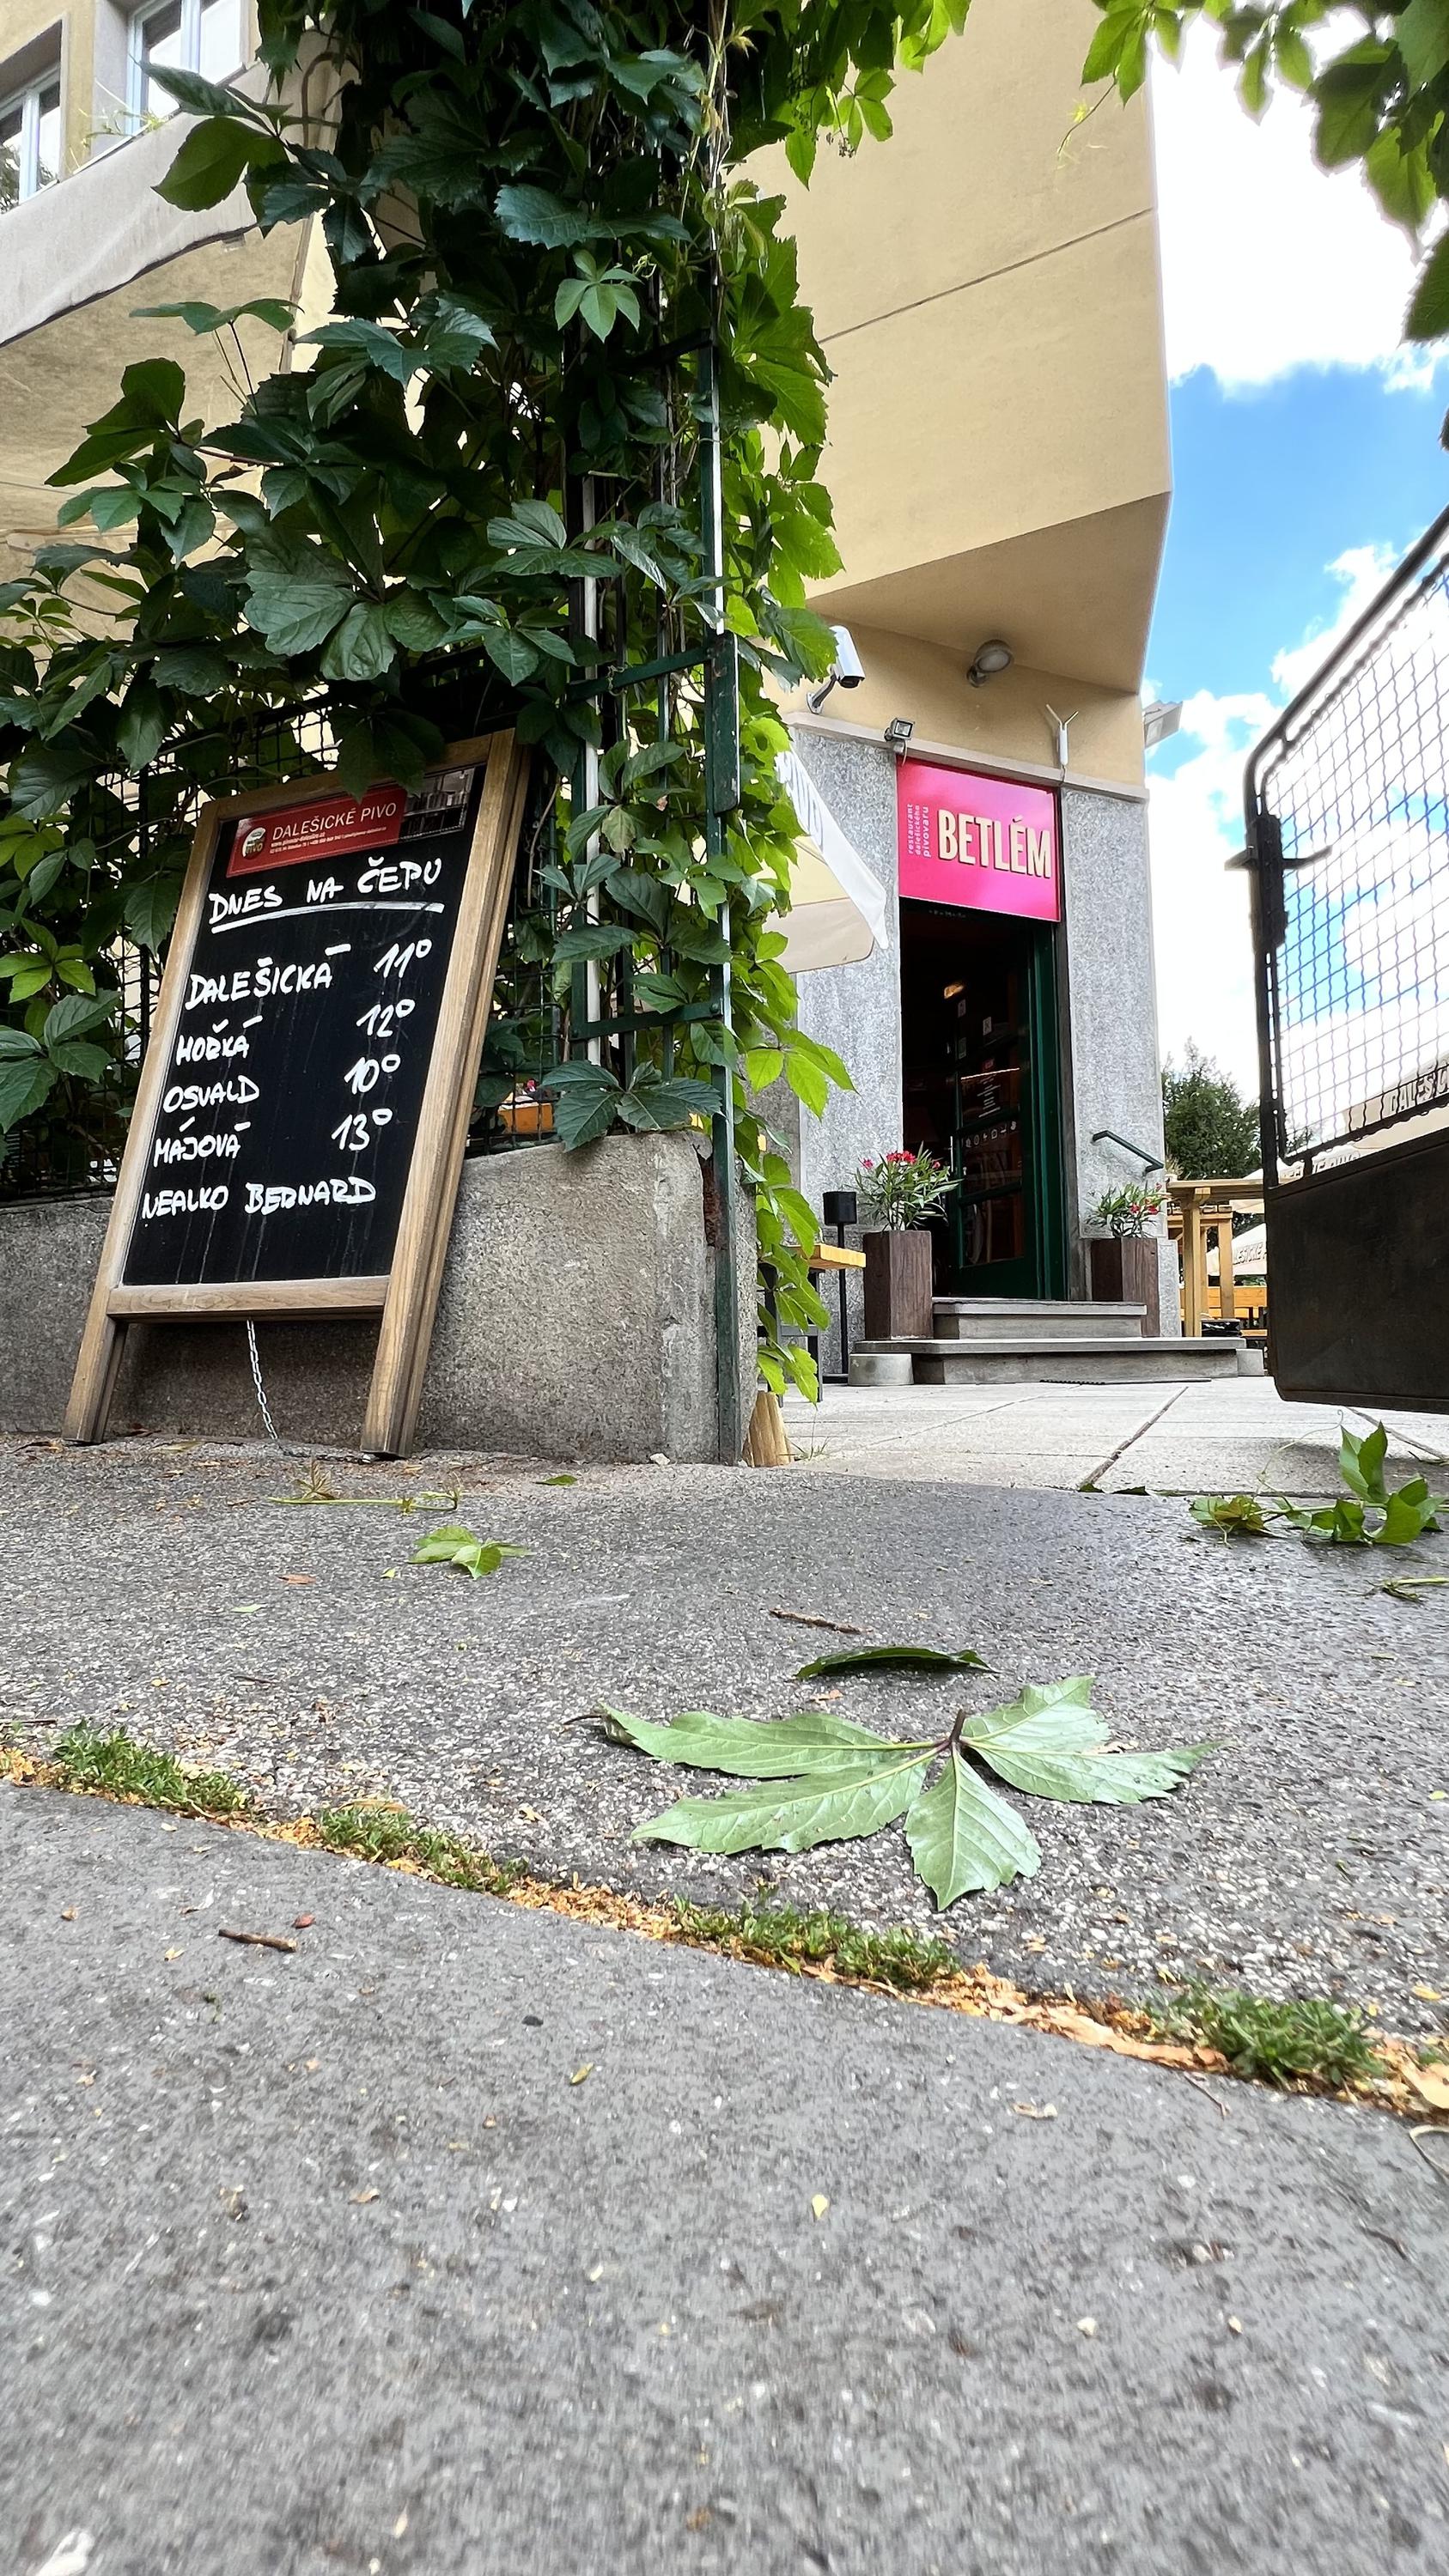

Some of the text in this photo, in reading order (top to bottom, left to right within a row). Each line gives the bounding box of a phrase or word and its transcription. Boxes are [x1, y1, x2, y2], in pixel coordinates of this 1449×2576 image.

[272, 807, 355, 841] DALEŠICKÉ
[360, 802, 397, 823] PIVO
[922, 806, 931, 858] pivovaru
[937, 809, 1051, 879] BETLÉM
[209, 856, 441, 924] DNES NA ČEPU
[185, 944, 351, 1011] DALEŠICKÁ
[175, 1014, 263, 1066] HOŘKÁ
[162, 1075, 259, 1114] OSVALD
[153, 1116, 251, 1168] MÁJOVÁ
[141, 1176, 376, 1219] NEALKO BERNARD
